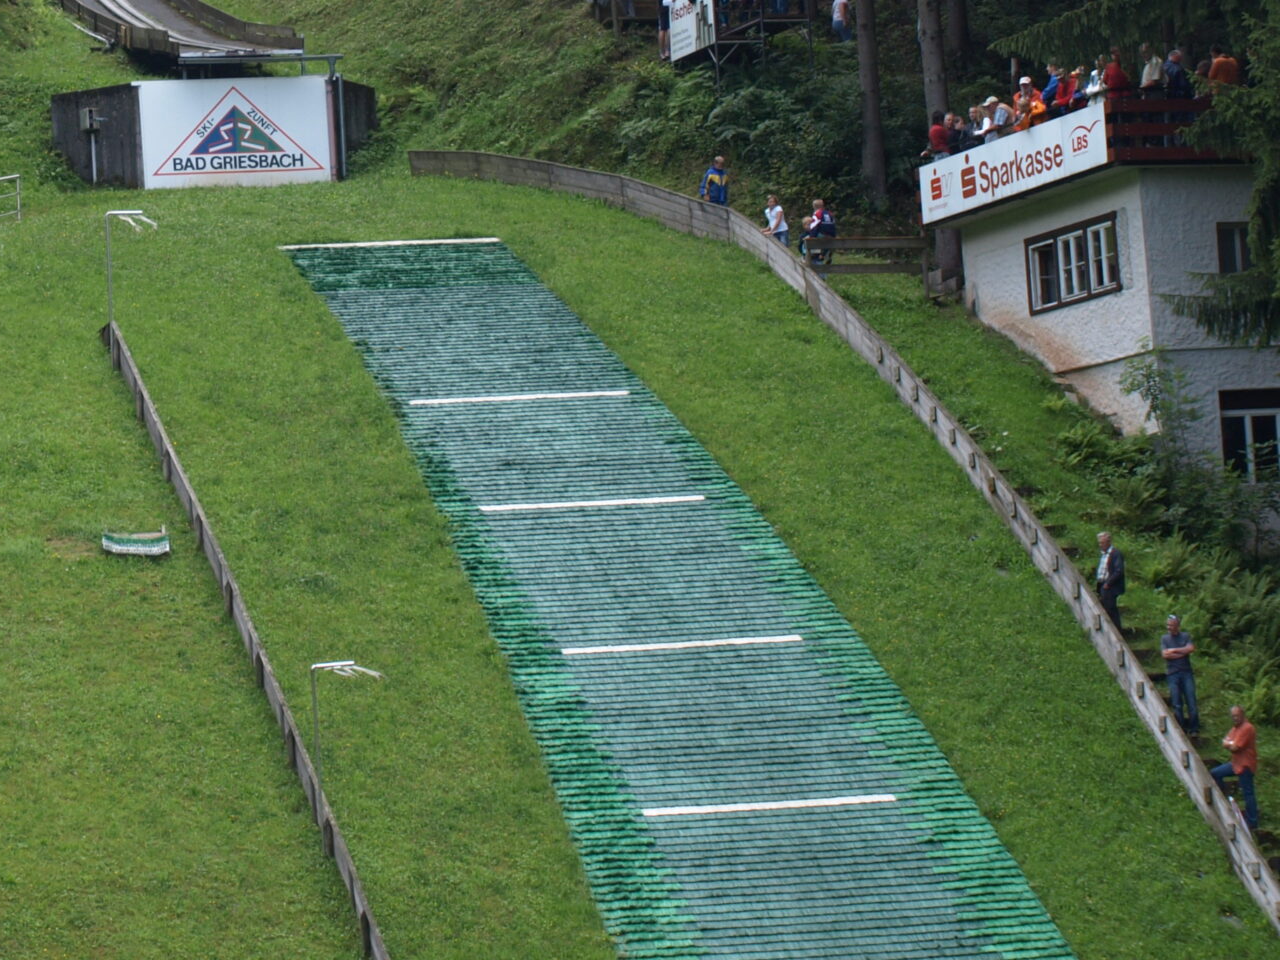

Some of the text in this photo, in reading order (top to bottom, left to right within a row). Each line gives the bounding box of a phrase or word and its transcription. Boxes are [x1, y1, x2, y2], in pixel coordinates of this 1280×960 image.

[196, 117, 215, 138] SKI-
[246, 107, 279, 136] ZUNFT
[1072, 134, 1089, 152] LBS
[173, 153, 304, 171] BAD GRIESBACH
[978, 144, 1063, 197] Sparkasse
